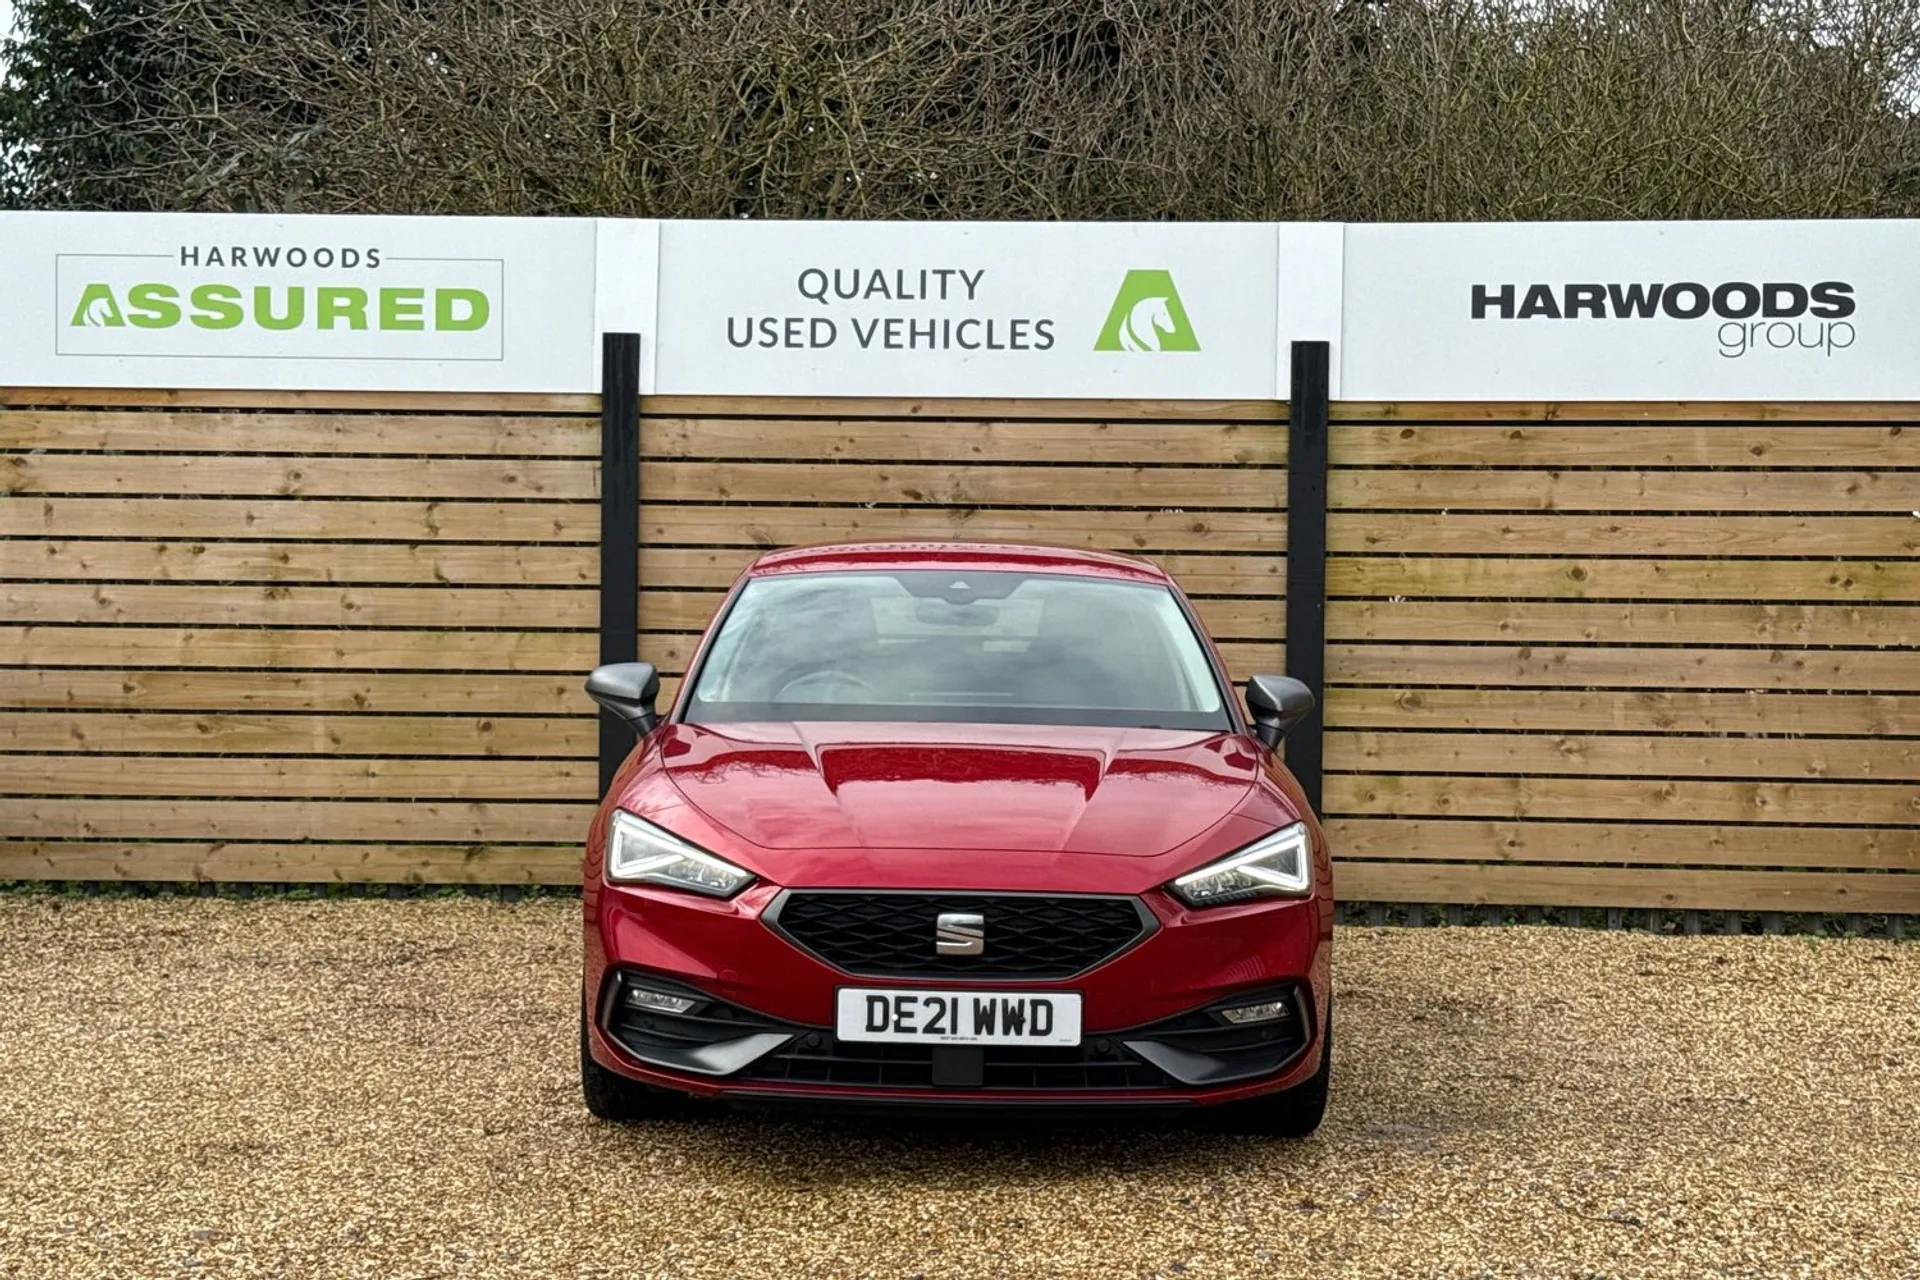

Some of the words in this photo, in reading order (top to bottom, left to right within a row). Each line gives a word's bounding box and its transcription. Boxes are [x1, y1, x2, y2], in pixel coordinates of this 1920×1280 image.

[180, 246, 381, 269] HARWOODS
[797, 268, 986, 304] QUALITY
[1471, 281, 1856, 319] HARWOODS
[70, 283, 490, 331] ASSURED
[727, 317, 837, 348] USED
[851, 318, 1055, 350] VEHICLES
[1717, 320, 1856, 358] group
[865, 994, 959, 1035] DE21
[973, 997, 1054, 1037] WWD
